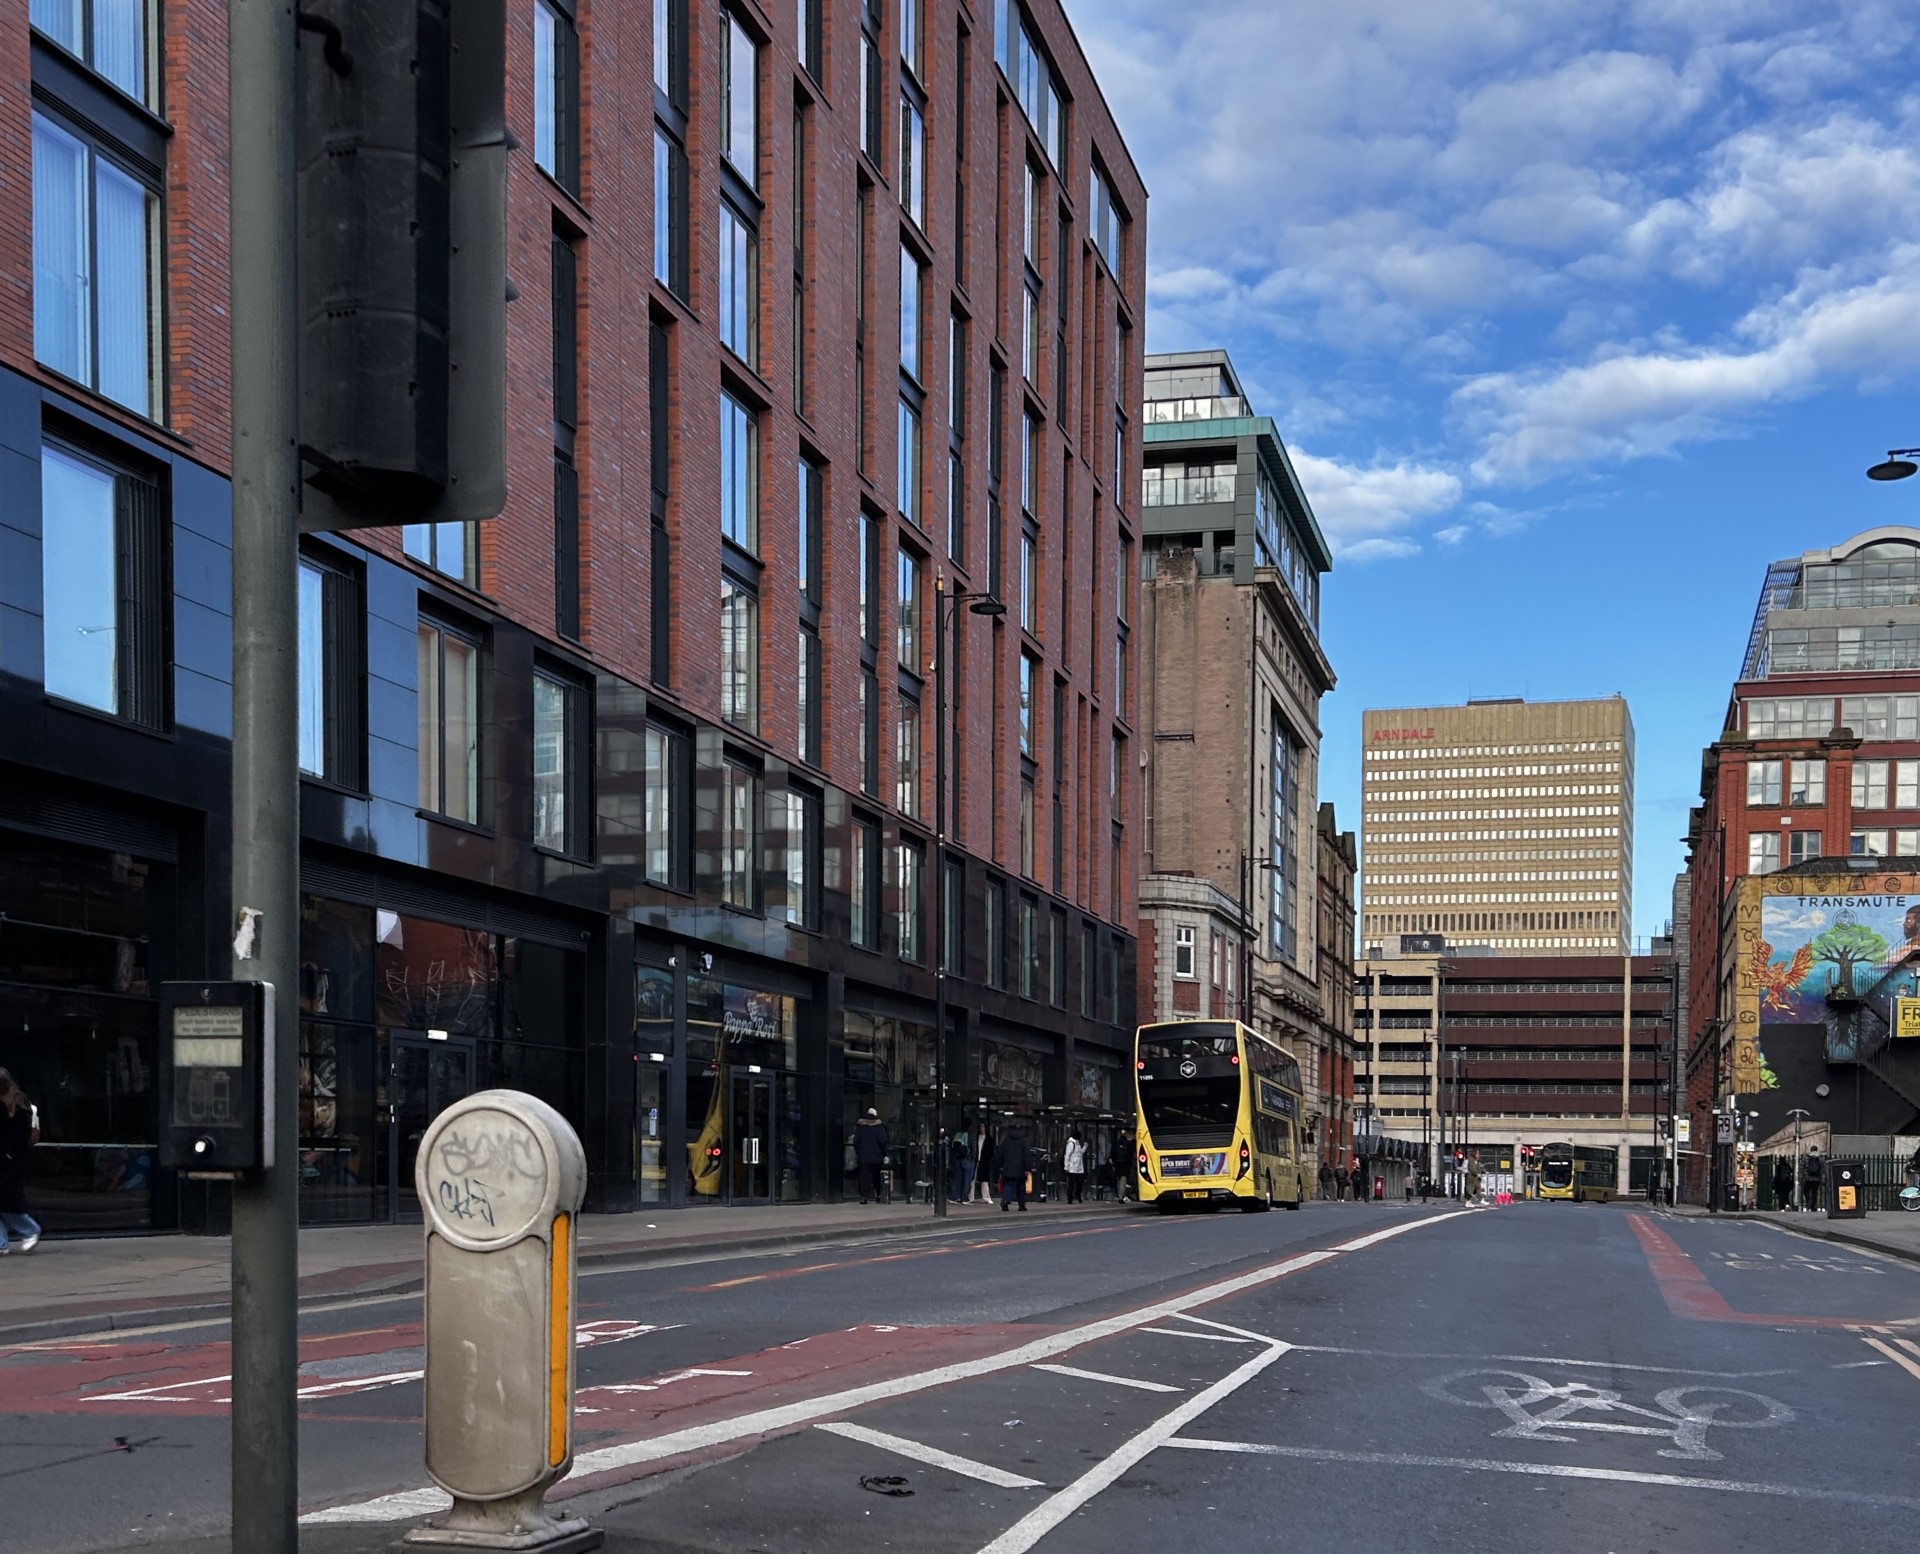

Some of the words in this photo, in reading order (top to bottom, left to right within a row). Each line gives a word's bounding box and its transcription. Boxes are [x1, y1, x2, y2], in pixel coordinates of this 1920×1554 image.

[1372, 727, 1435, 741] ARNDALE
[1797, 896, 1906, 907] TRANSMUTE
[724, 1011, 752, 1044] Pappa
